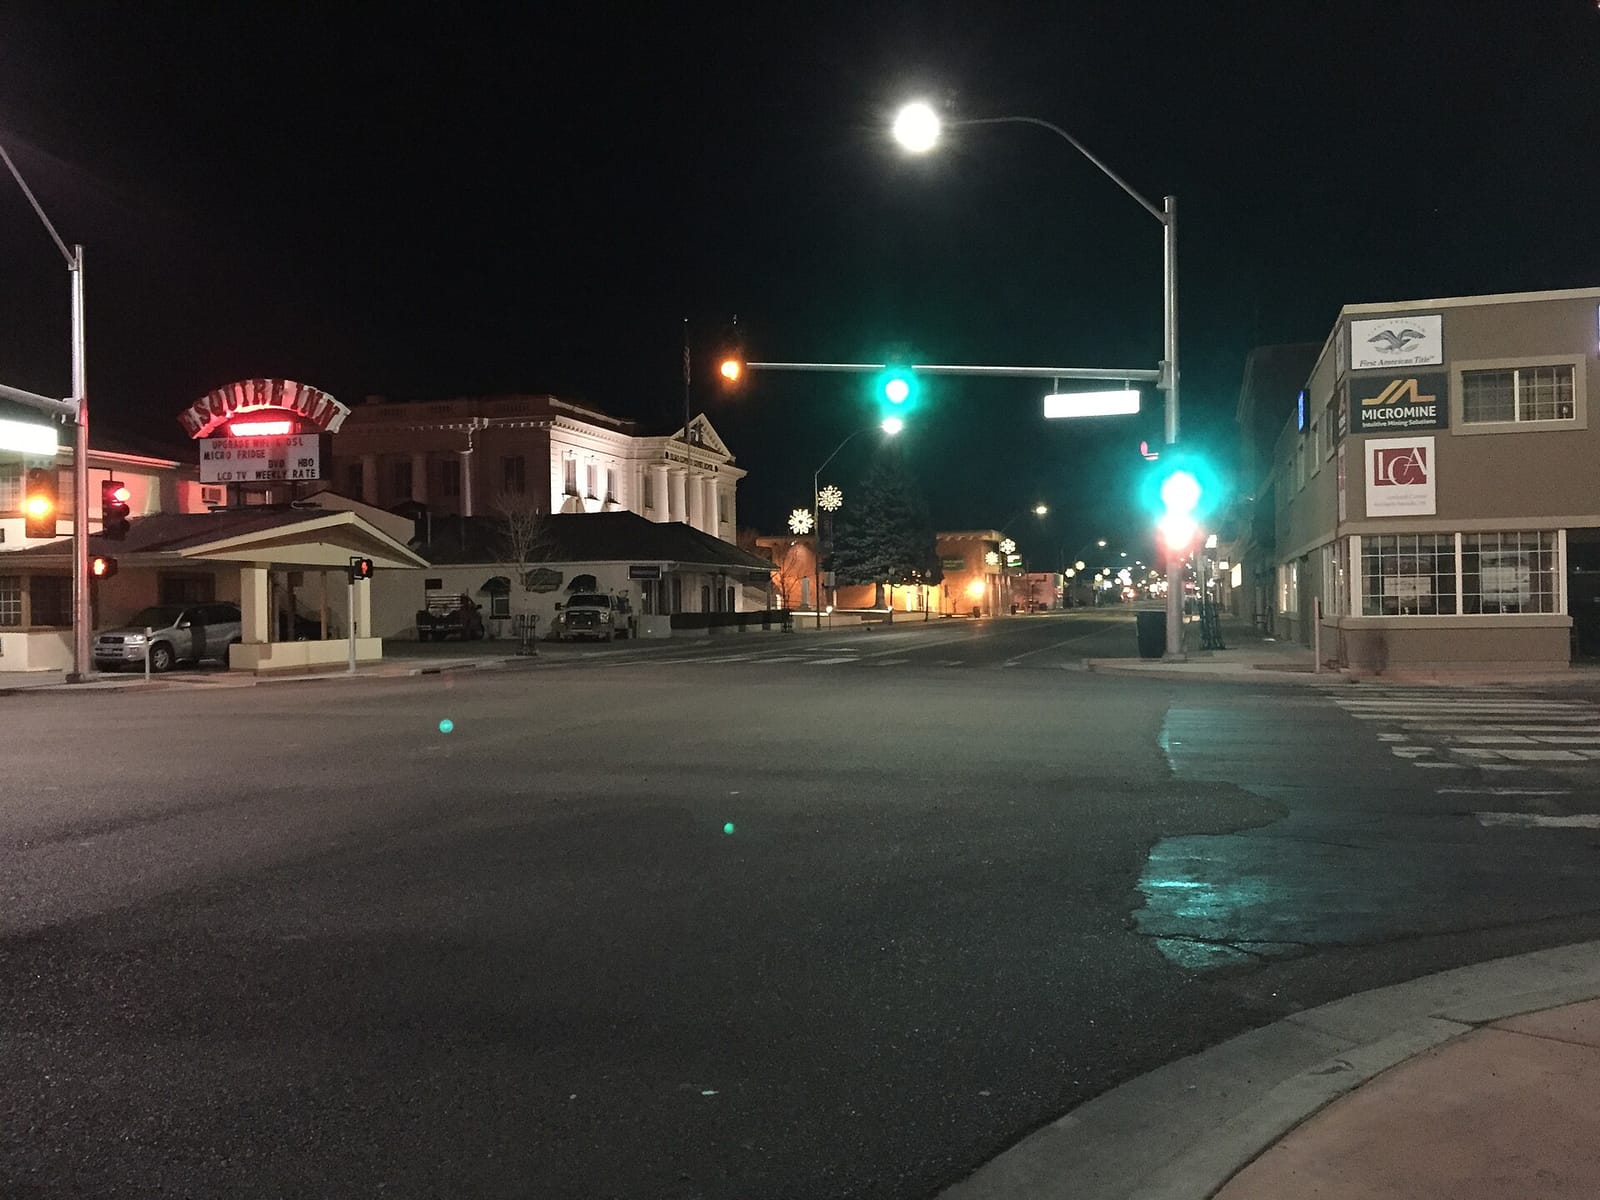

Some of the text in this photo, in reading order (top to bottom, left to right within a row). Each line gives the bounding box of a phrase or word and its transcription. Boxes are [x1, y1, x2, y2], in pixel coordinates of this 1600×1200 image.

[1379, 358, 1413, 366] American
[290, 382, 348, 431] INN
[1362, 406, 1437, 420] MICROMINE
[212, 438, 250, 450] UPGRADE
[286, 437, 304, 447] DSL
[203, 449, 266, 461] MICRO FRIDGE
[268, 458, 314, 469] DVD HBO
[1377, 447, 1427, 487] LCA
[217, 469, 316, 481] LCD TV WEEKLY RATE
